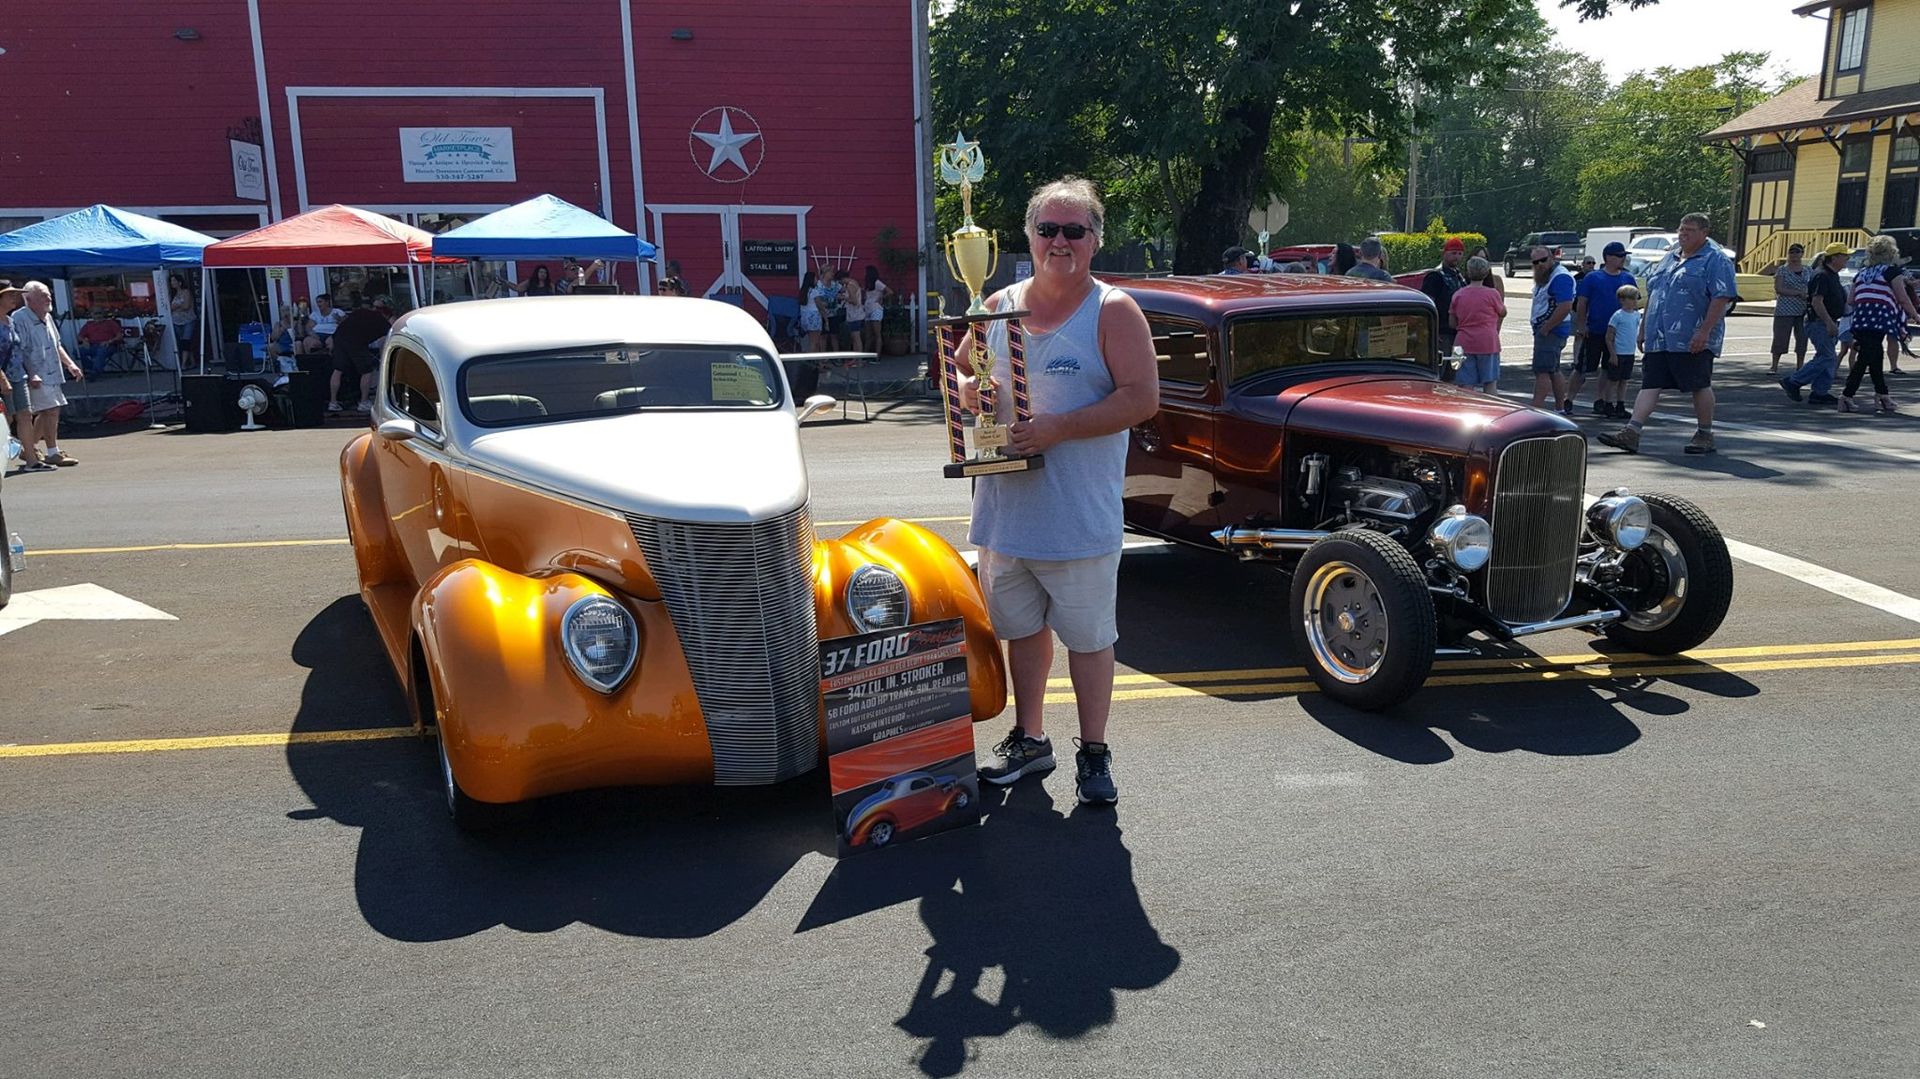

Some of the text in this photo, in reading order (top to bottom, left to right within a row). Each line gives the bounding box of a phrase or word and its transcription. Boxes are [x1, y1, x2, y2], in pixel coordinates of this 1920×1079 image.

[421, 131, 450, 143] Old
[824, 648, 851, 676] 37
[854, 632, 910, 668] FORD
[840, 702, 860, 716] FORD
[932, 676, 951, 690] REAR
[952, 672, 966, 684] END
[848, 683, 867, 700] 347
[869, 679, 884, 694] CU.
[886, 676, 899, 690] IN.
[901, 662, 944, 685] STROKER
[873, 725, 904, 742] GRAPHICS
